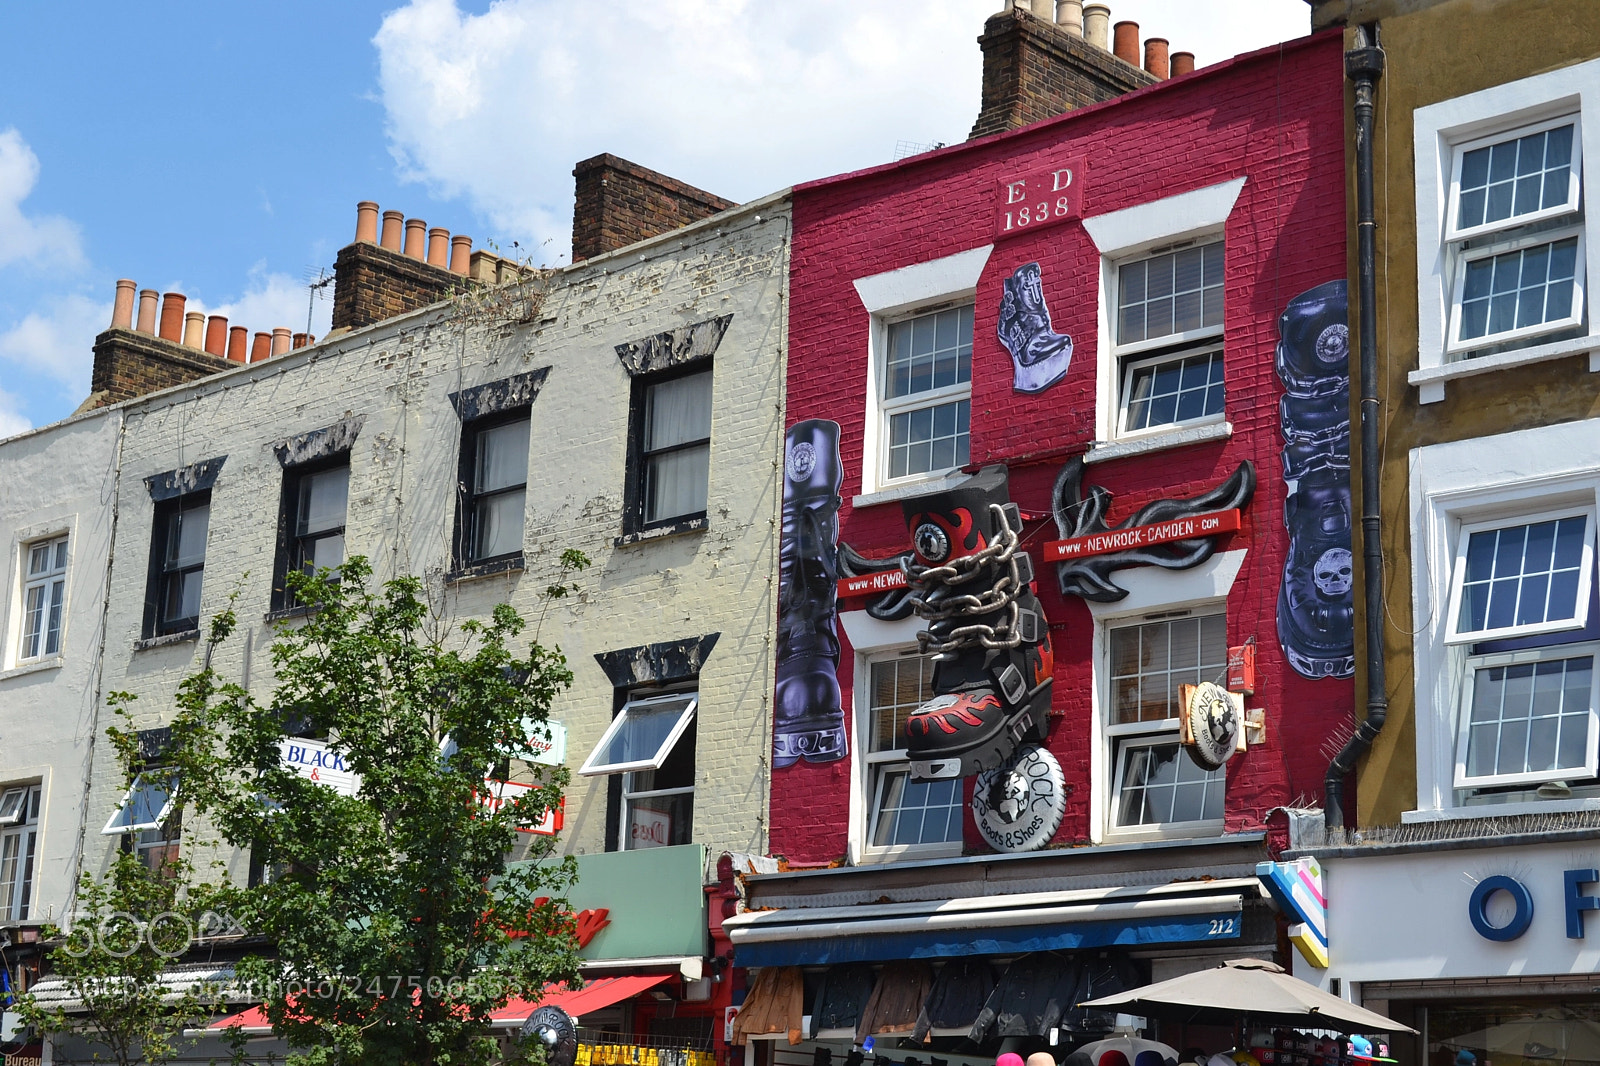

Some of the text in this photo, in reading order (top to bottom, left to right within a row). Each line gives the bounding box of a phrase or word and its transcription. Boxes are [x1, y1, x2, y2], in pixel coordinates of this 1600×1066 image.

[1005, 168, 1073, 205] E D
[1003, 196, 1069, 231] 1838
[287, 745, 346, 771] BLACK
[310, 767, 320, 781] &
[1020, 746, 1054, 812] ROCK
[980, 815, 1044, 849] Boots & Shoes
[1208, 918, 1234, 935] 212
